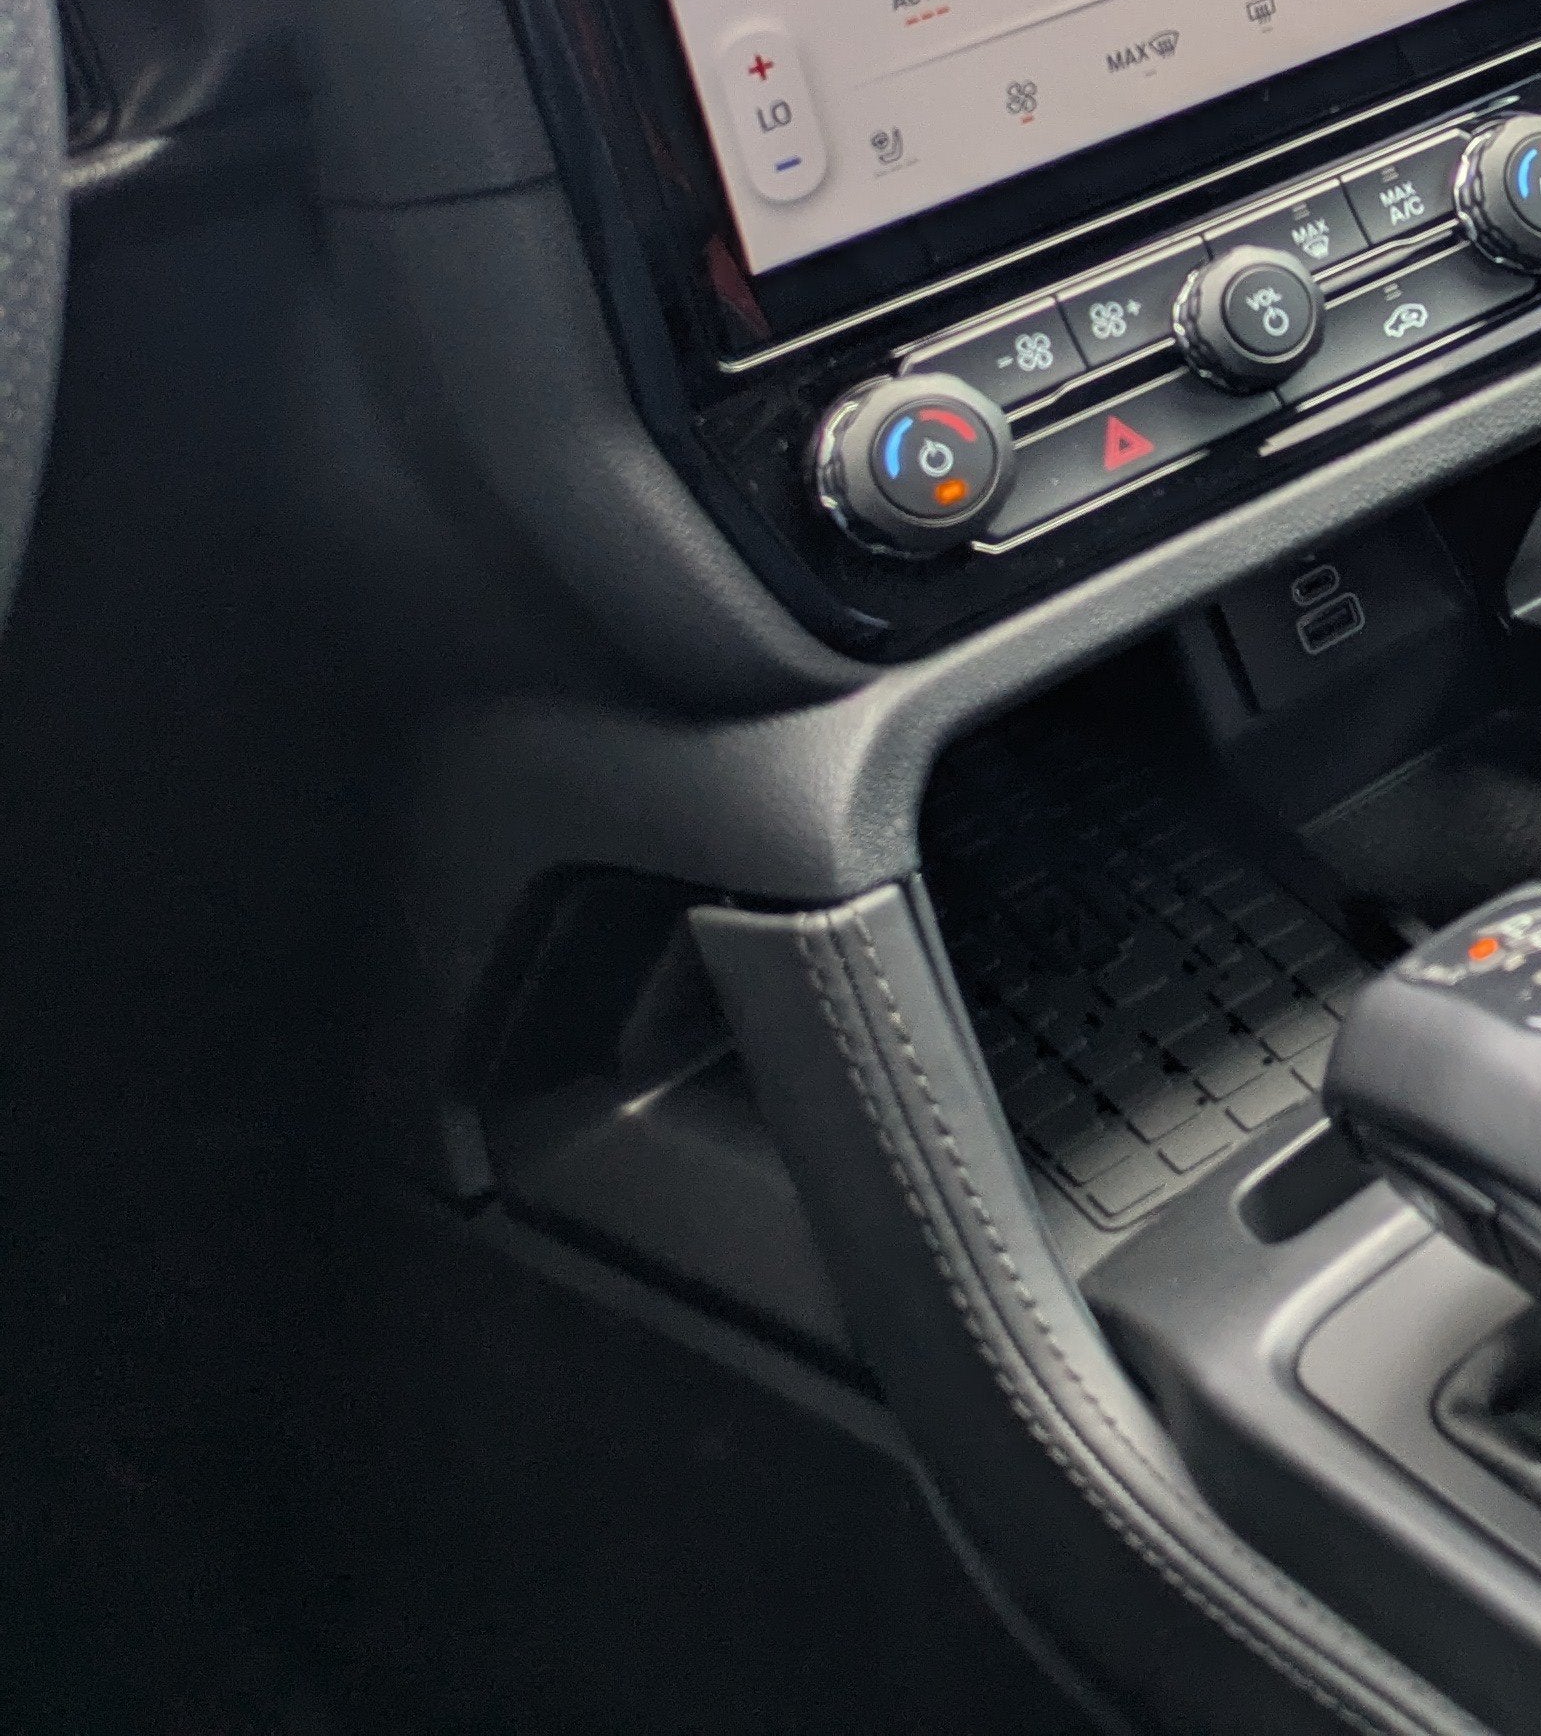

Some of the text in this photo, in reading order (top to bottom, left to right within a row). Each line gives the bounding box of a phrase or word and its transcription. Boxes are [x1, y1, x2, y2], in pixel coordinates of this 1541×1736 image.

[1106, 42, 1149, 73] MAX
[757, 99, 793, 134] LO
[1379, 180, 1418, 208] MAX
[1388, 195, 1426, 226] A/C
[1291, 218, 1330, 246] MAX
[1245, 286, 1283, 312] VOL
